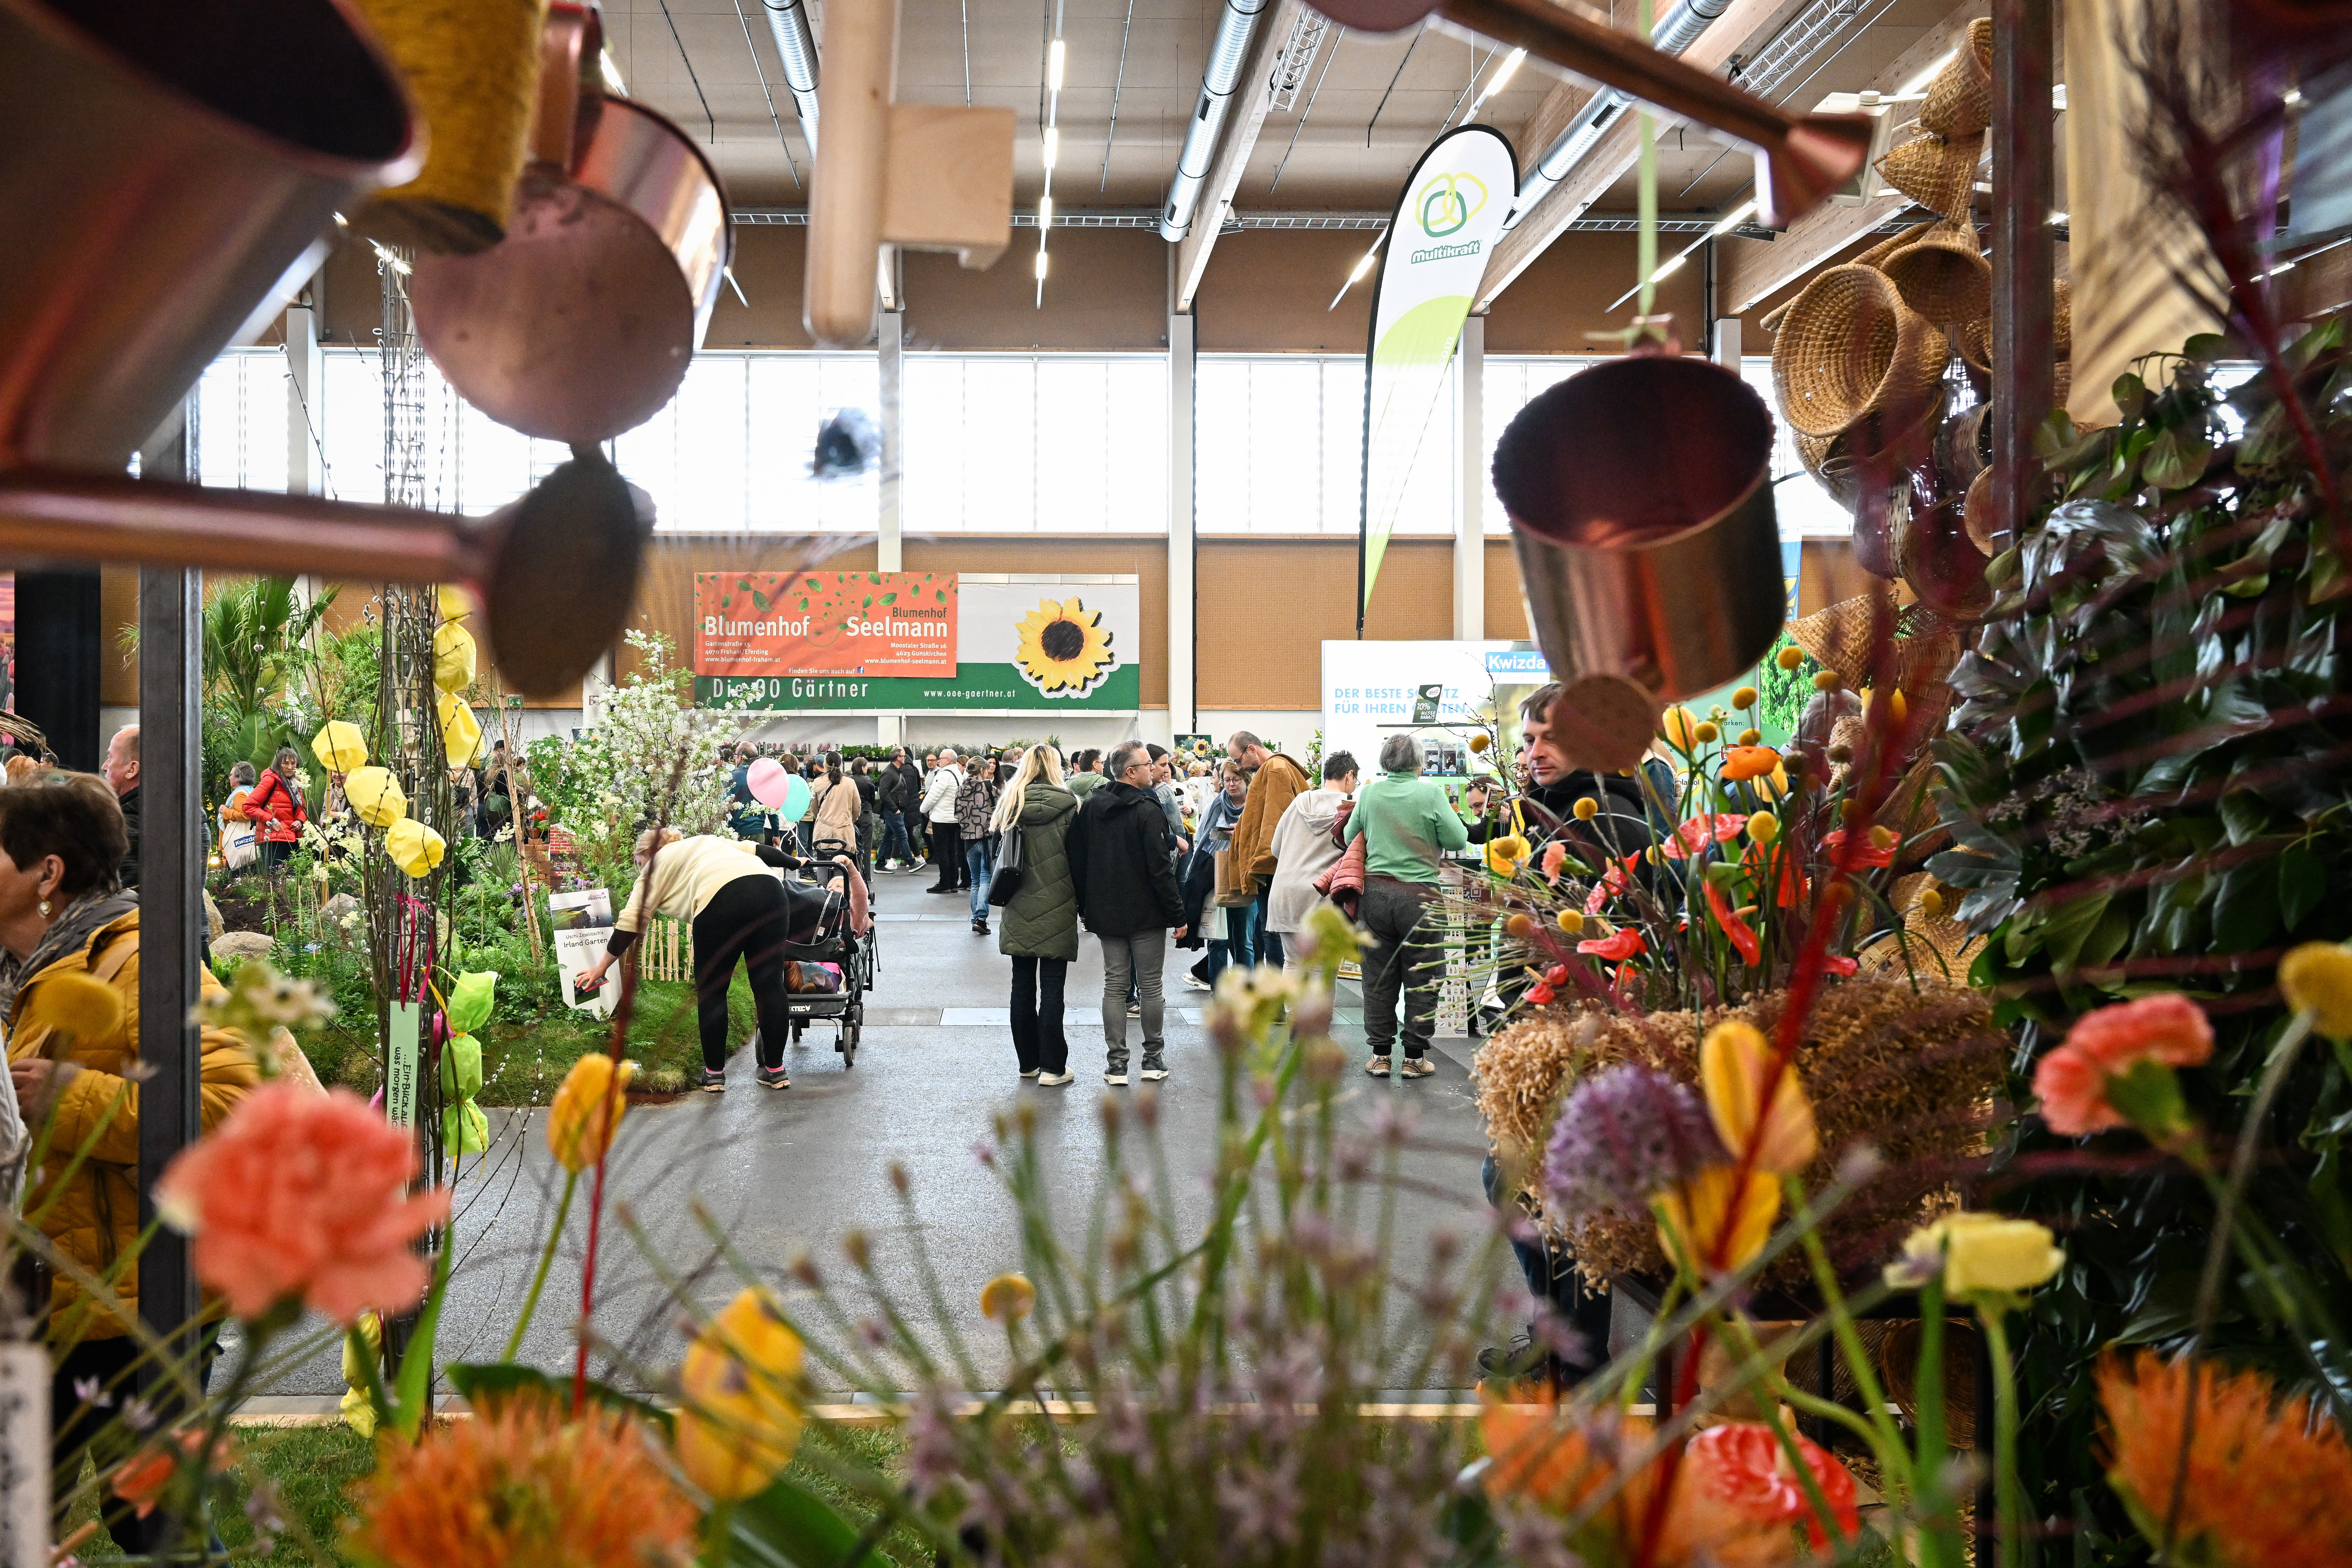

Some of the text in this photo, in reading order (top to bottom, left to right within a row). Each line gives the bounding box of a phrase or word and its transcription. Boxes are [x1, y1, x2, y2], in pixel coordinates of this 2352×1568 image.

[893, 607, 947, 618] Blumenhof
[705, 615, 811, 636] Blumenhof
[846, 616, 948, 637] Seelmann
[1488, 655, 1546, 669] Kwizda
[713, 678, 743, 698] Die
[792, 678, 868, 698] Gärtner
[1335, 688, 1359, 698] DER
[1365, 688, 1401, 698] BESTE
[924, 690, 1015, 699] www.ooe-gaertner.at
[1335, 700, 1360, 713] FÜR
[1365, 703, 1406, 713] IHREN
[1417, 702, 1431, 710] 10%
[564, 938, 608, 948] Irland Garten
